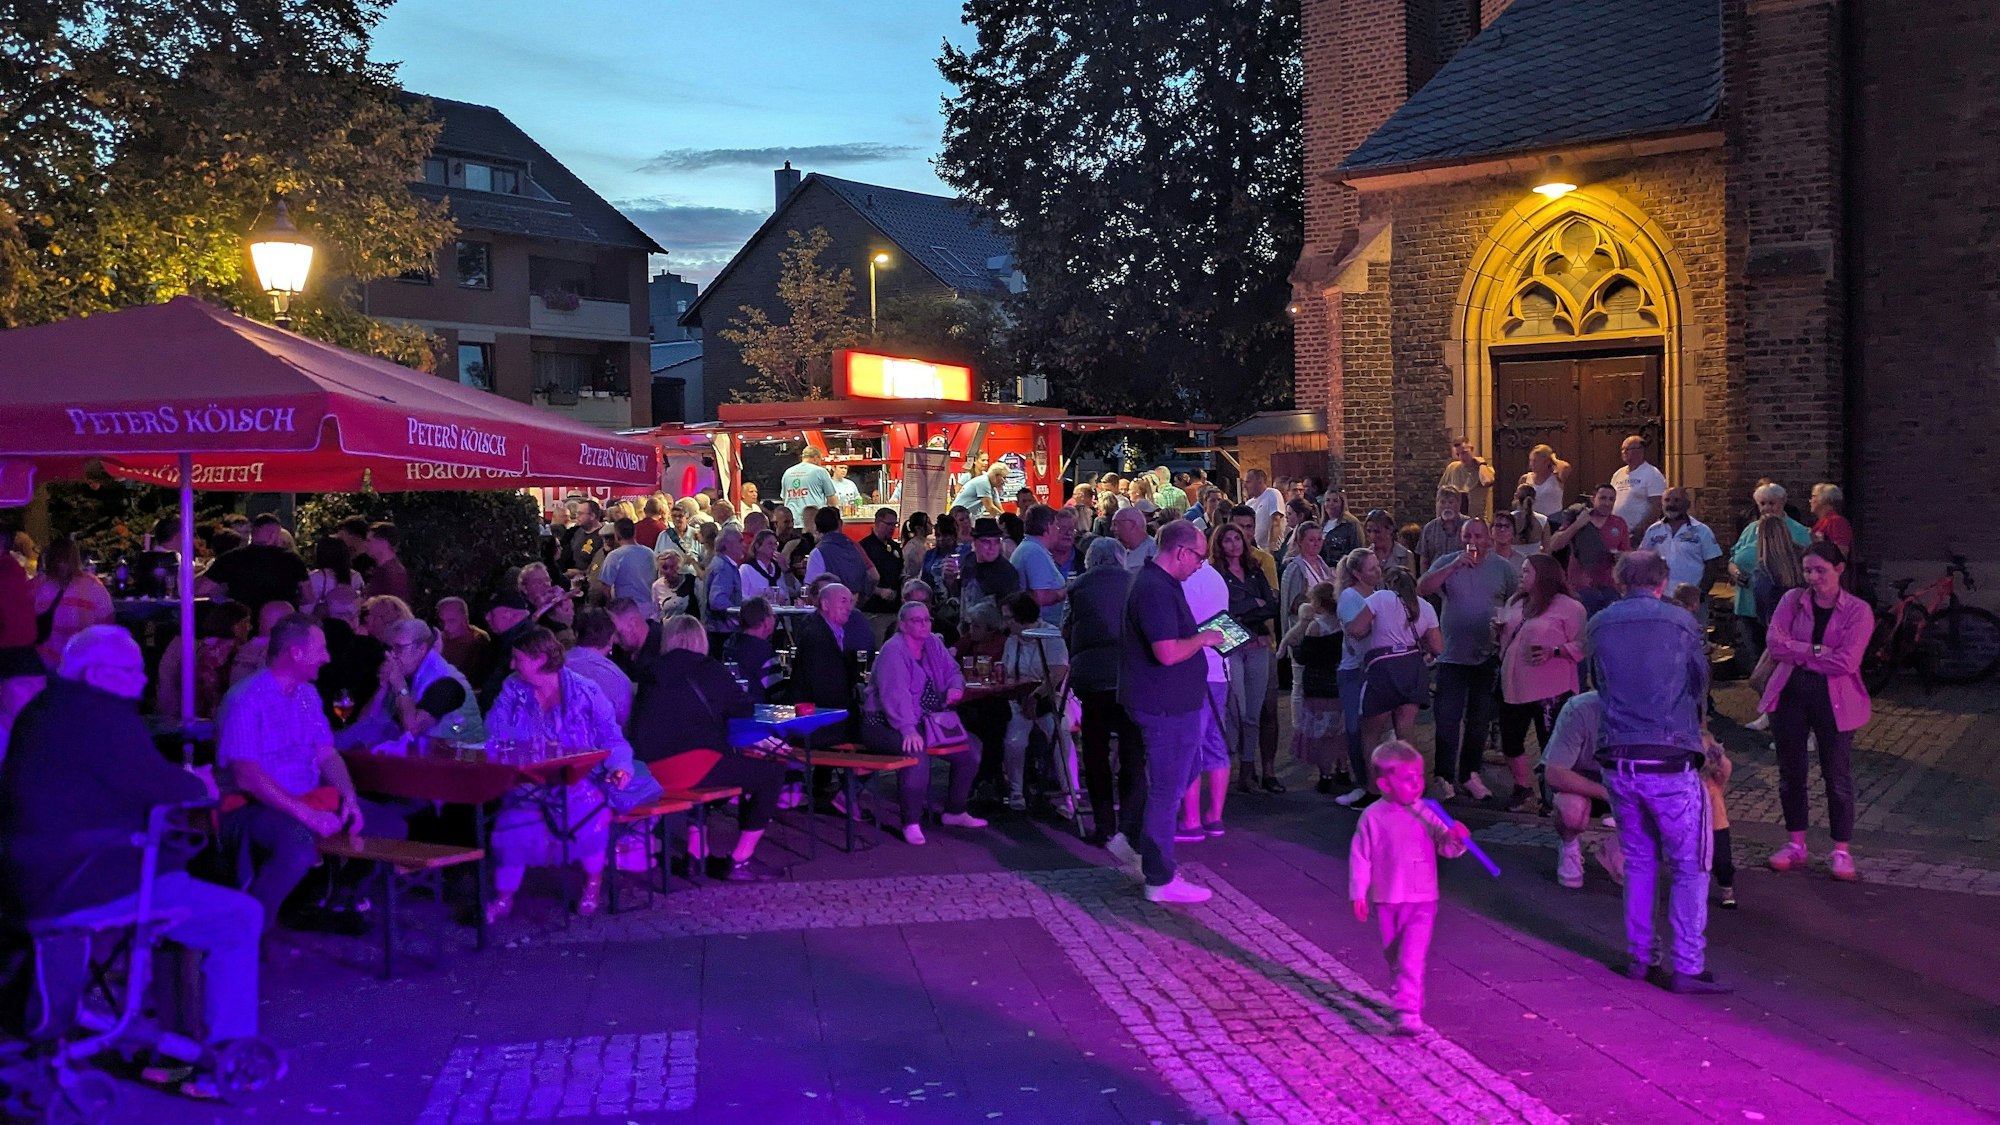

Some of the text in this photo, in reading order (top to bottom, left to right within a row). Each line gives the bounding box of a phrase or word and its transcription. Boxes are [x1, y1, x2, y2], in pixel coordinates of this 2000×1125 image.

[66, 404, 295, 435] PETERS KÖLSCH
[407, 417, 506, 457] PETERS KÖLSCH
[579, 443, 615, 468] PETERS
[787, 487, 808, 497] TMG
